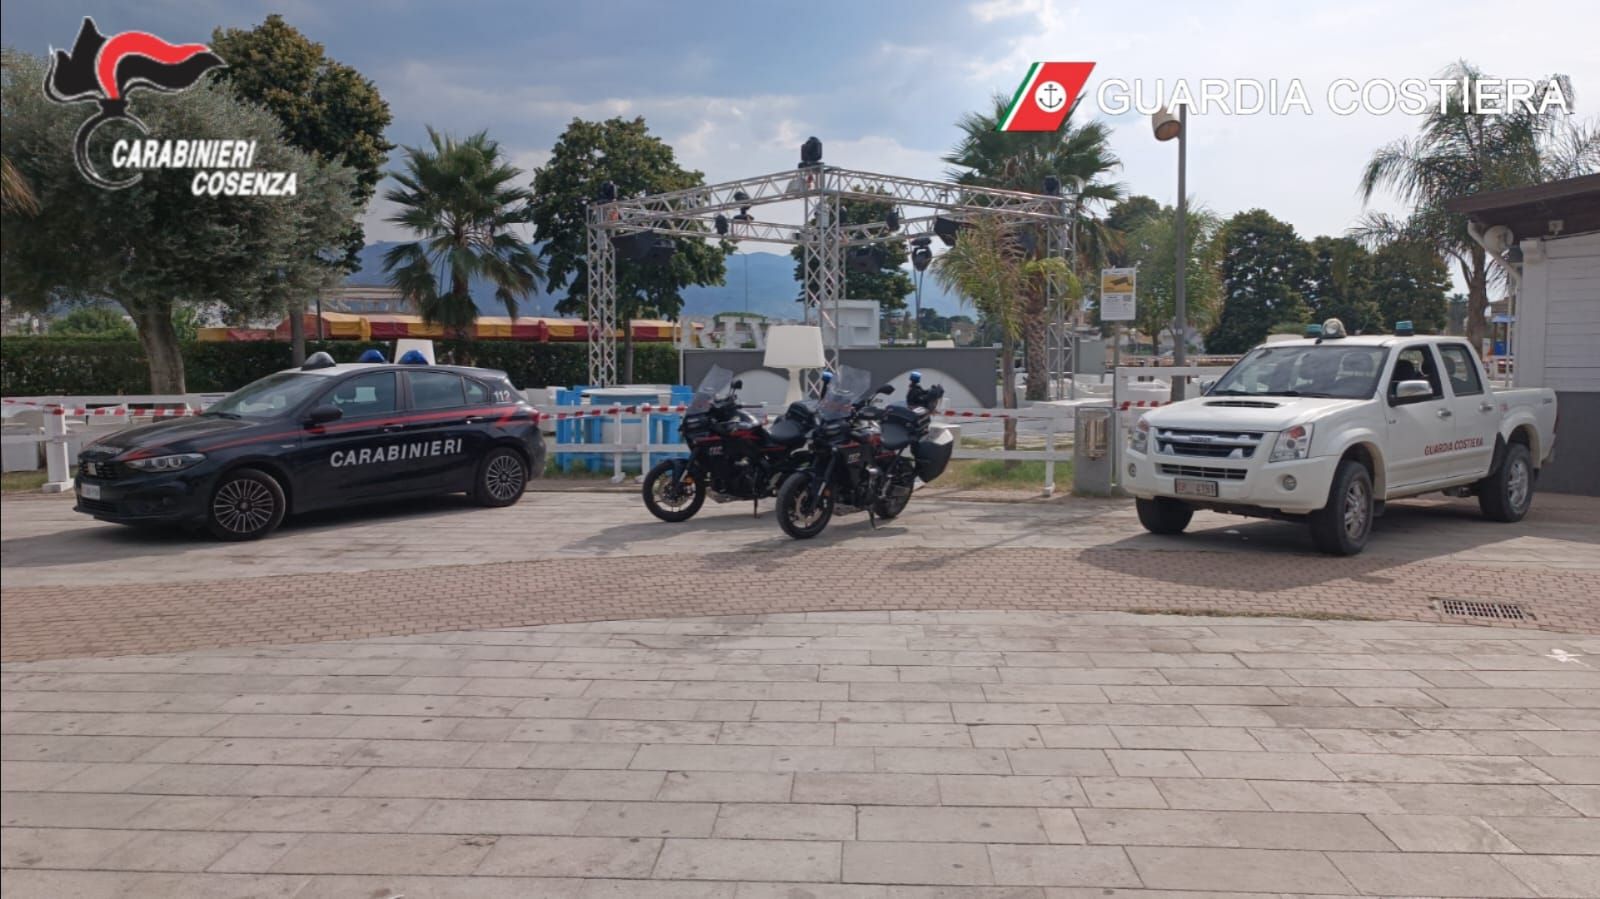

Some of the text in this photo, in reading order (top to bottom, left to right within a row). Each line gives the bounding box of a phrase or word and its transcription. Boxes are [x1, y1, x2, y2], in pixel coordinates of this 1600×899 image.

[493, 390, 511, 402] 112
[329, 438, 463, 468] CARABINIERI
[1424, 437, 1484, 456] GUARDIA COSTIERA
